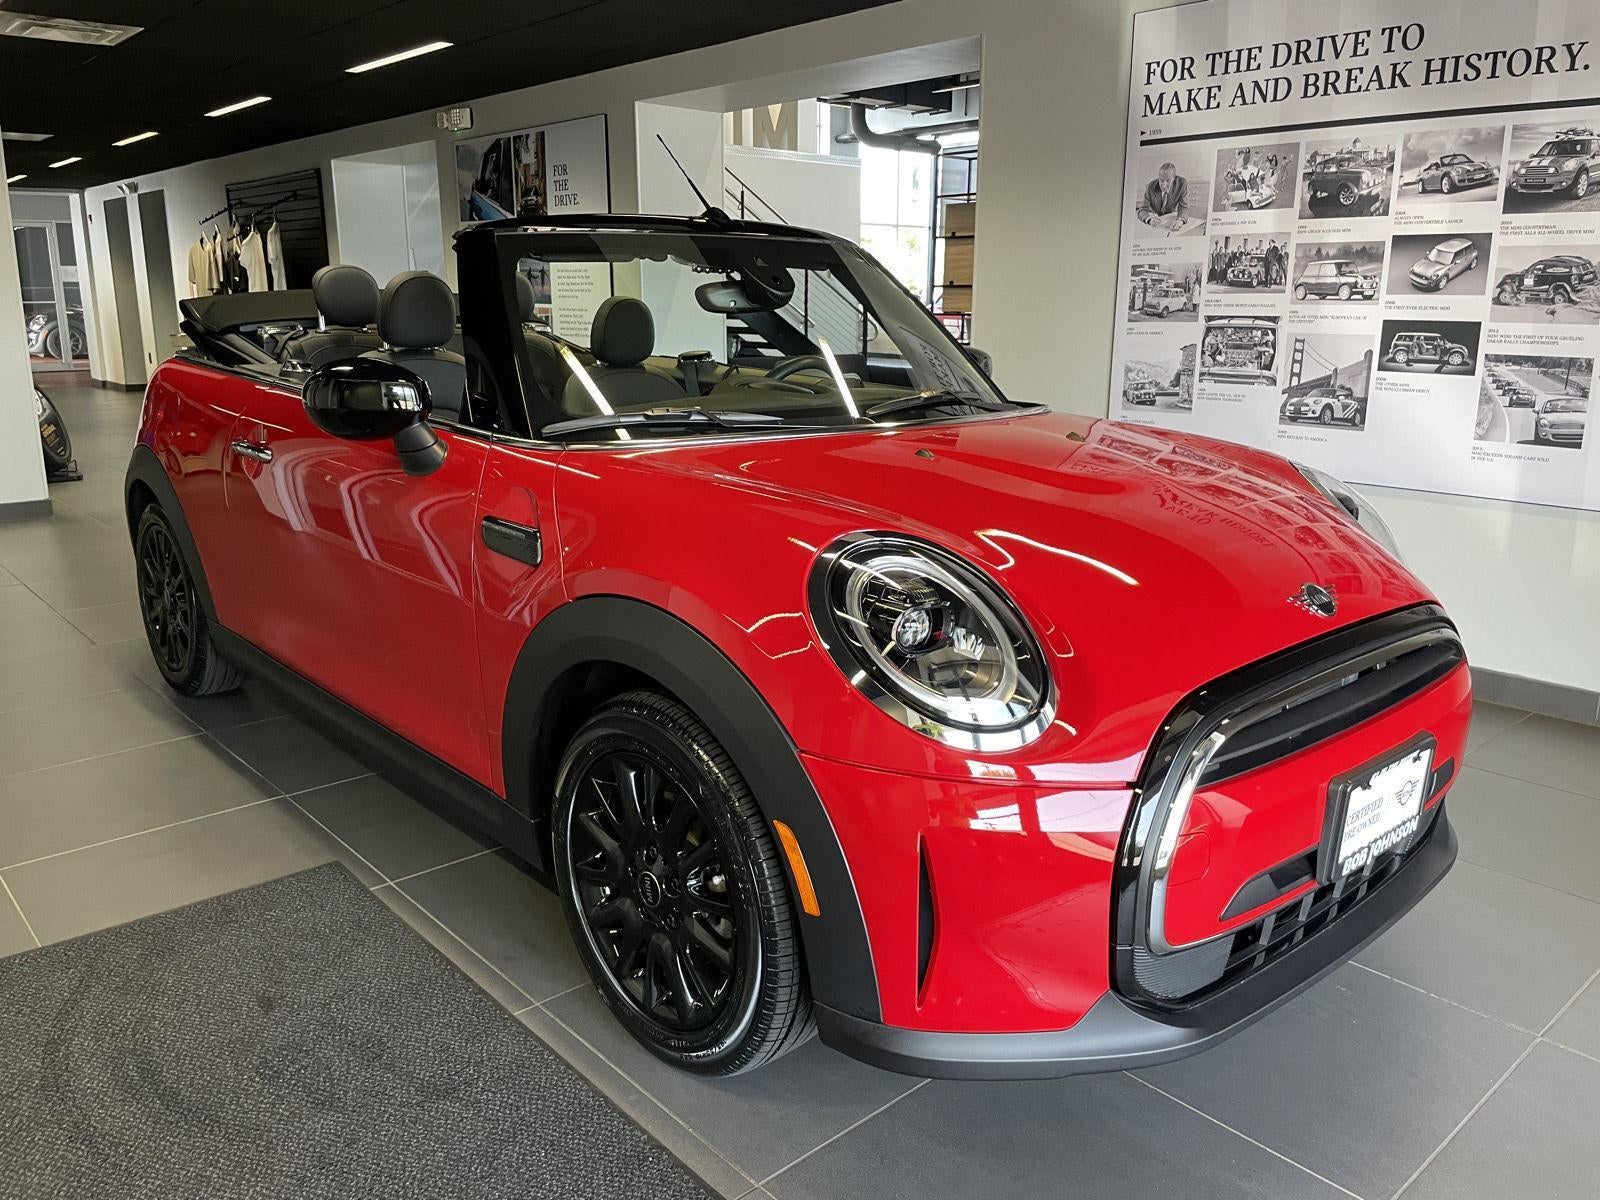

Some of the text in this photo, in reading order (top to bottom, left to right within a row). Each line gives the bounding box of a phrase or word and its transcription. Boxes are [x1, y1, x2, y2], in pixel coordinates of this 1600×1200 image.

[1144, 23, 1424, 86] FOR THE DRIVE TO
[1142, 41, 1590, 118] MAKE AND BREAK HISTORY.
[552, 164, 568, 176] FOR
[554, 179, 569, 192] THE
[554, 193, 580, 206] DRIVE.
[1346, 797, 1384, 827] CERTIFIED
[1344, 813, 1381, 842] PRE-OWNED
[1342, 815, 1420, 876] BOB JOHNSON
[644, 876, 654, 903] MINI
